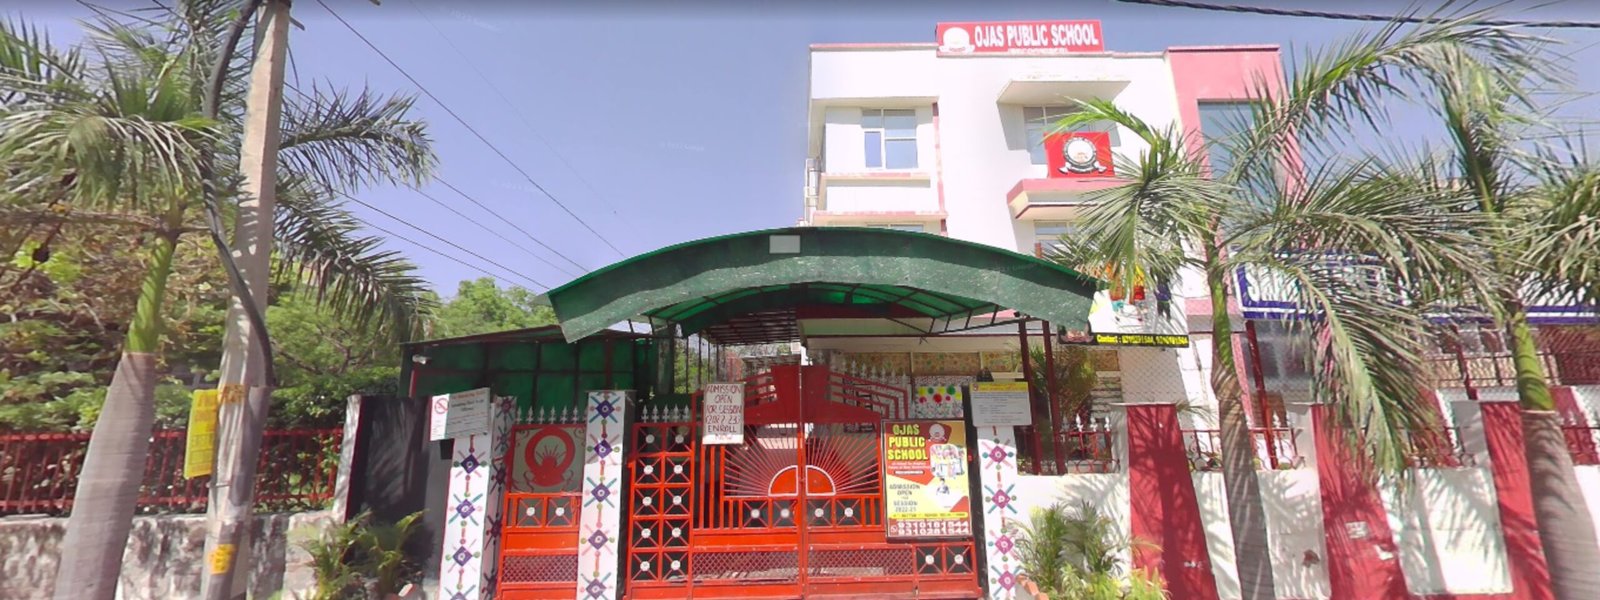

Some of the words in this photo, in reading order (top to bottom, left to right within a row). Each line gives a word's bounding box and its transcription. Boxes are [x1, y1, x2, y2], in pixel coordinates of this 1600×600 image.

[974, 26, 1004, 47] OJAS
[1008, 24, 1048, 46] PUBLIC
[1050, 24, 1098, 45] SCHOOL
[714, 394, 732, 404] OPEN
[892, 424, 920, 436] OJAS
[888, 436, 924, 448] PUBLIC
[888, 448, 928, 460] SCHOOL
